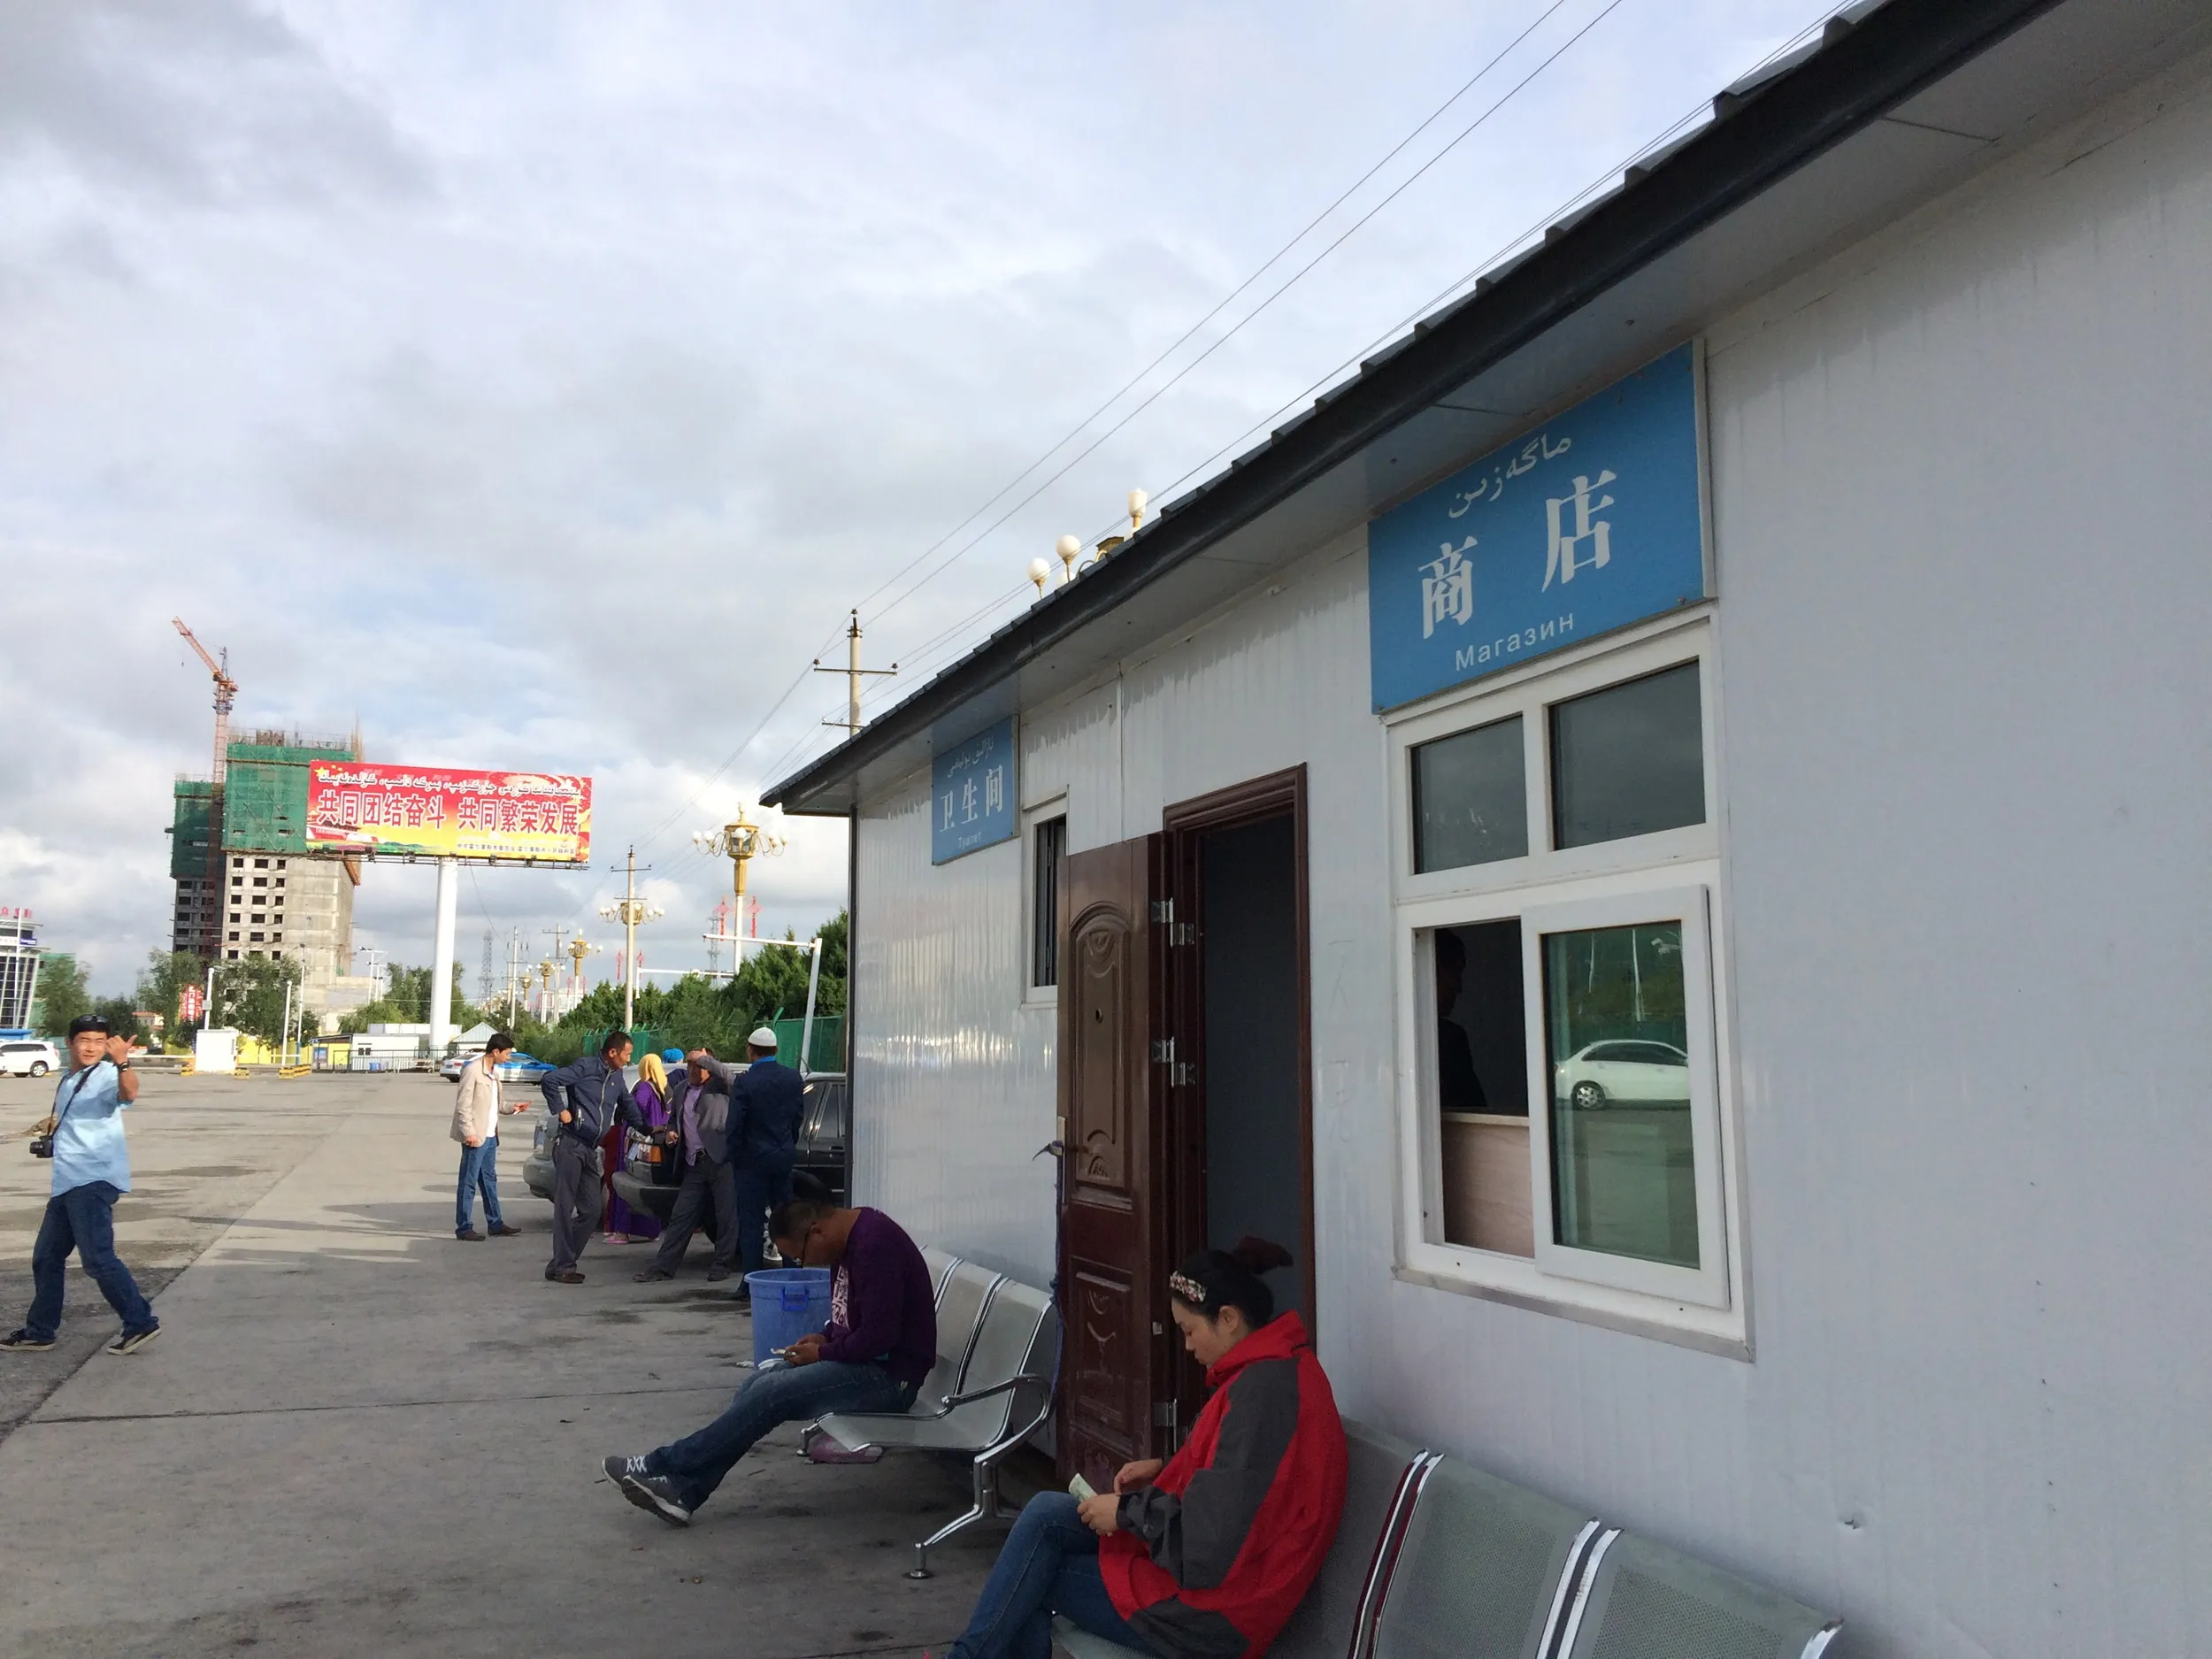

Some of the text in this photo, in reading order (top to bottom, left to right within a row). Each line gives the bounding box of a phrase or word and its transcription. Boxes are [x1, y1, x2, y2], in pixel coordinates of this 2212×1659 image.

[1418, 469, 1617, 640] 商店
[1455, 613, 1574, 671] Магазин
[317, 789, 580, 835] 共同团结奋斗 共同繁荣发展
[940, 764, 1002, 833] 卫生间
